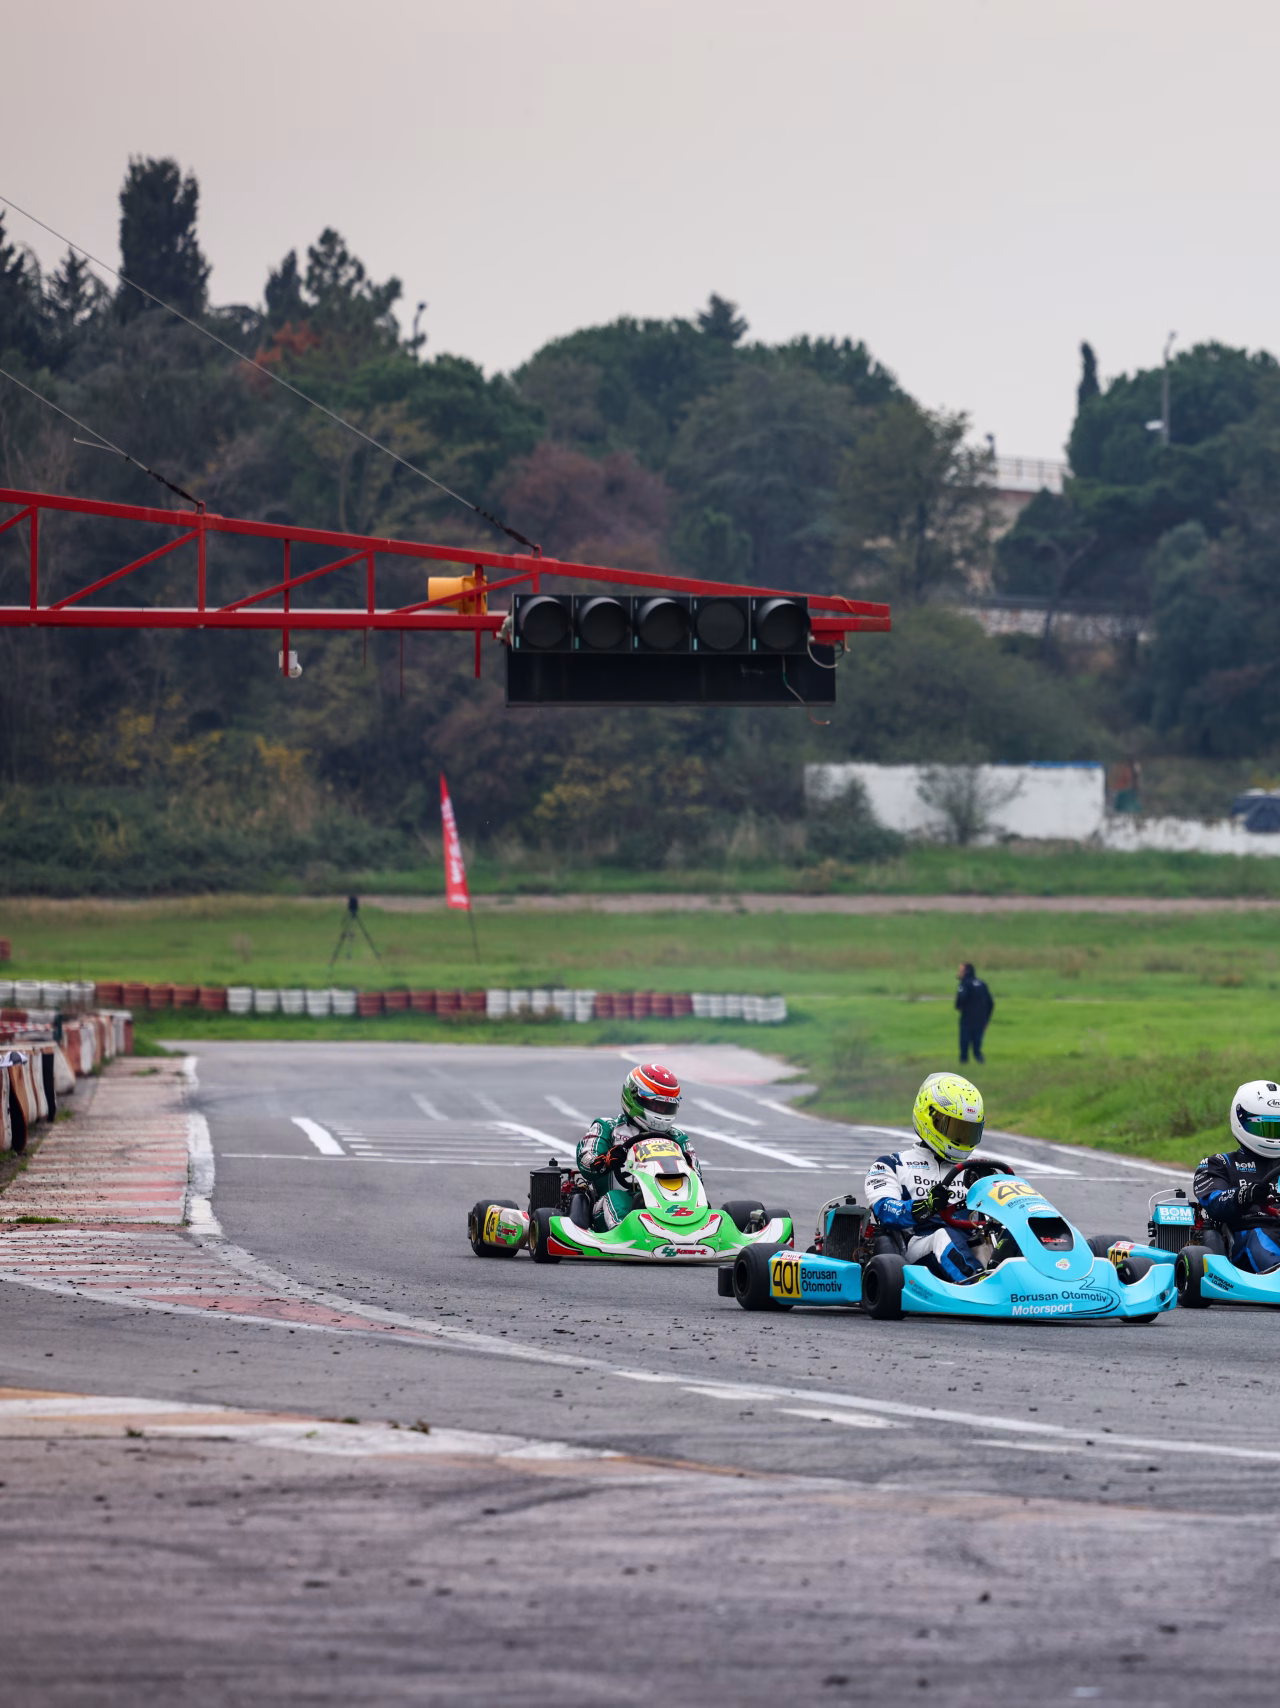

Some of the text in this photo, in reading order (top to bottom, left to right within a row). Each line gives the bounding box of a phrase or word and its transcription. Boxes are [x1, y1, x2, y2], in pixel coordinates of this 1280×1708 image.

[997, 1184, 1040, 1200] 40
[1160, 1207, 1192, 1216] BOM
[773, 1260, 800, 1295] 401
[801, 1268, 837, 1280] Borusan
[801, 1280, 842, 1292] Otomotiv
[1010, 1290, 1107, 1303] Borusan Otomotiv
[1012, 1302, 1074, 1316] Motorsport
